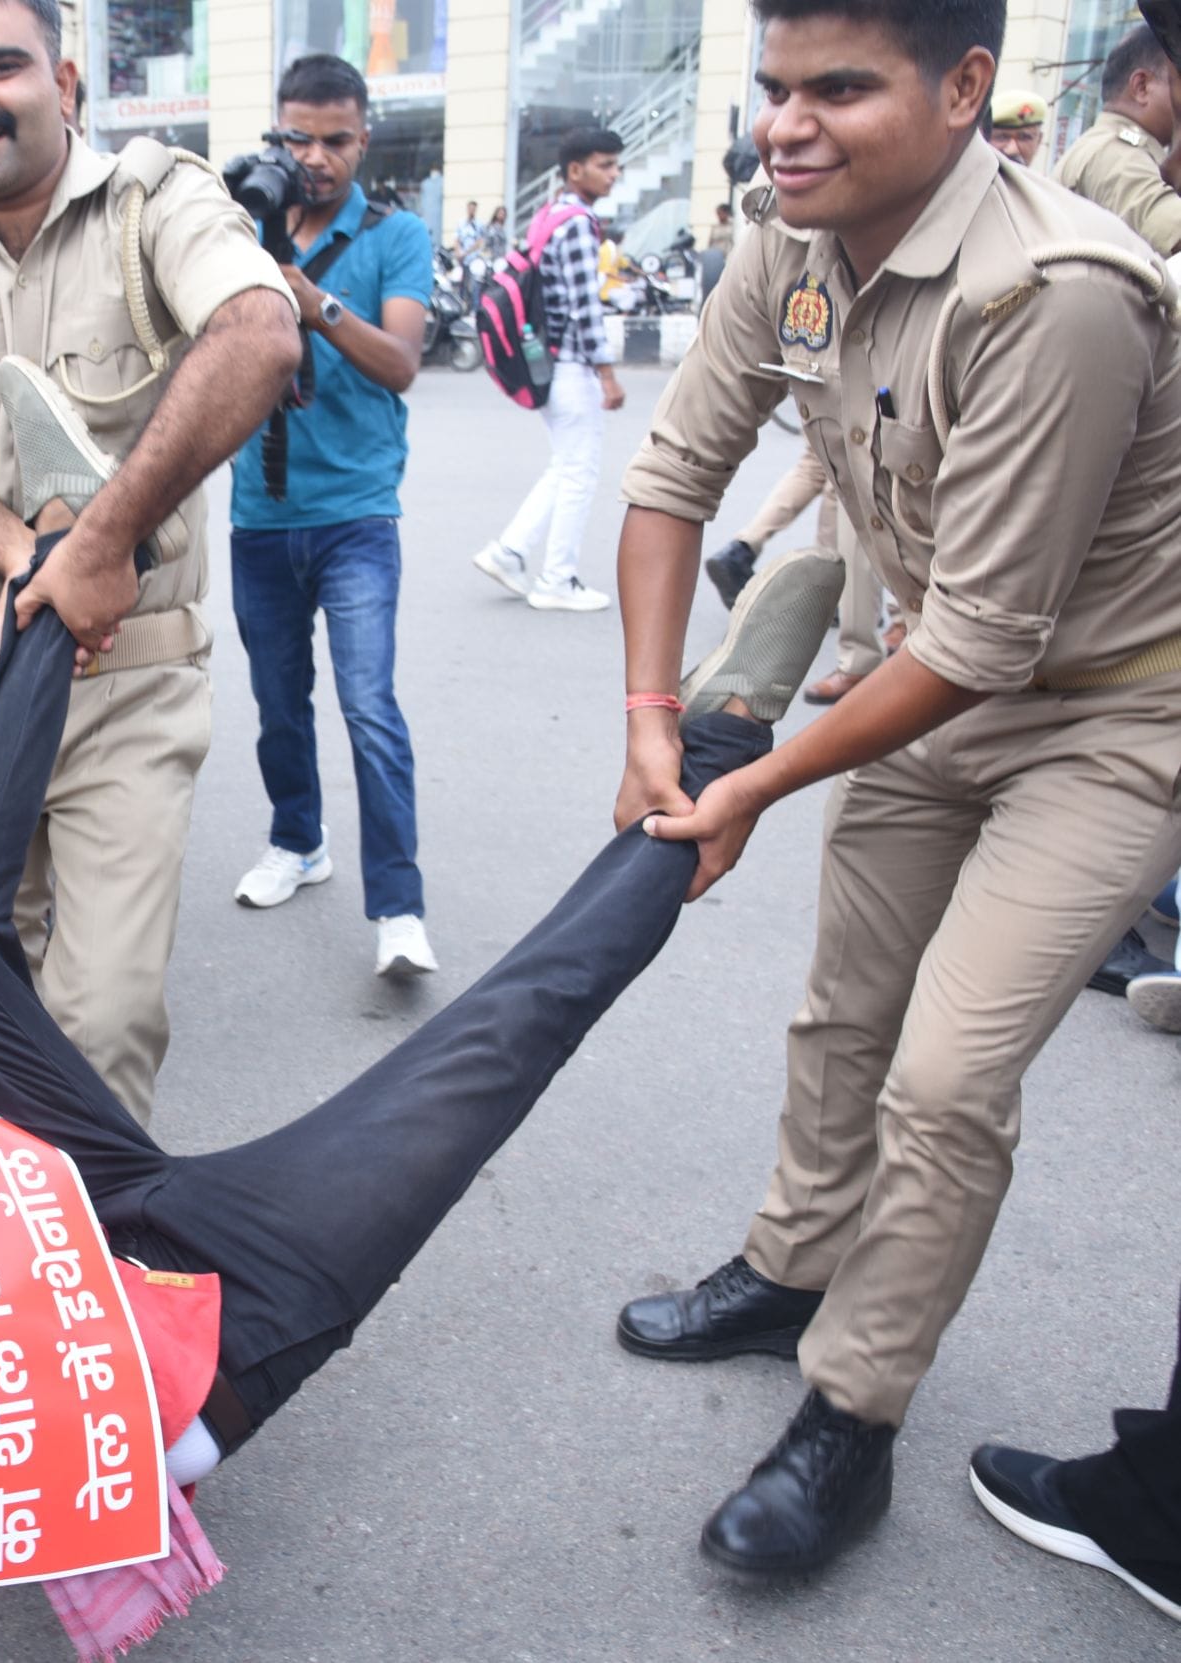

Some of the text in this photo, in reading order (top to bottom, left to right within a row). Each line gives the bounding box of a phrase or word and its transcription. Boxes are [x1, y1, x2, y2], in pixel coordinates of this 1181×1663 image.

[118, 100, 210, 117] Chhangama
[56, 1341, 116, 1399] में
[76, 1412, 132, 1519] तेल
